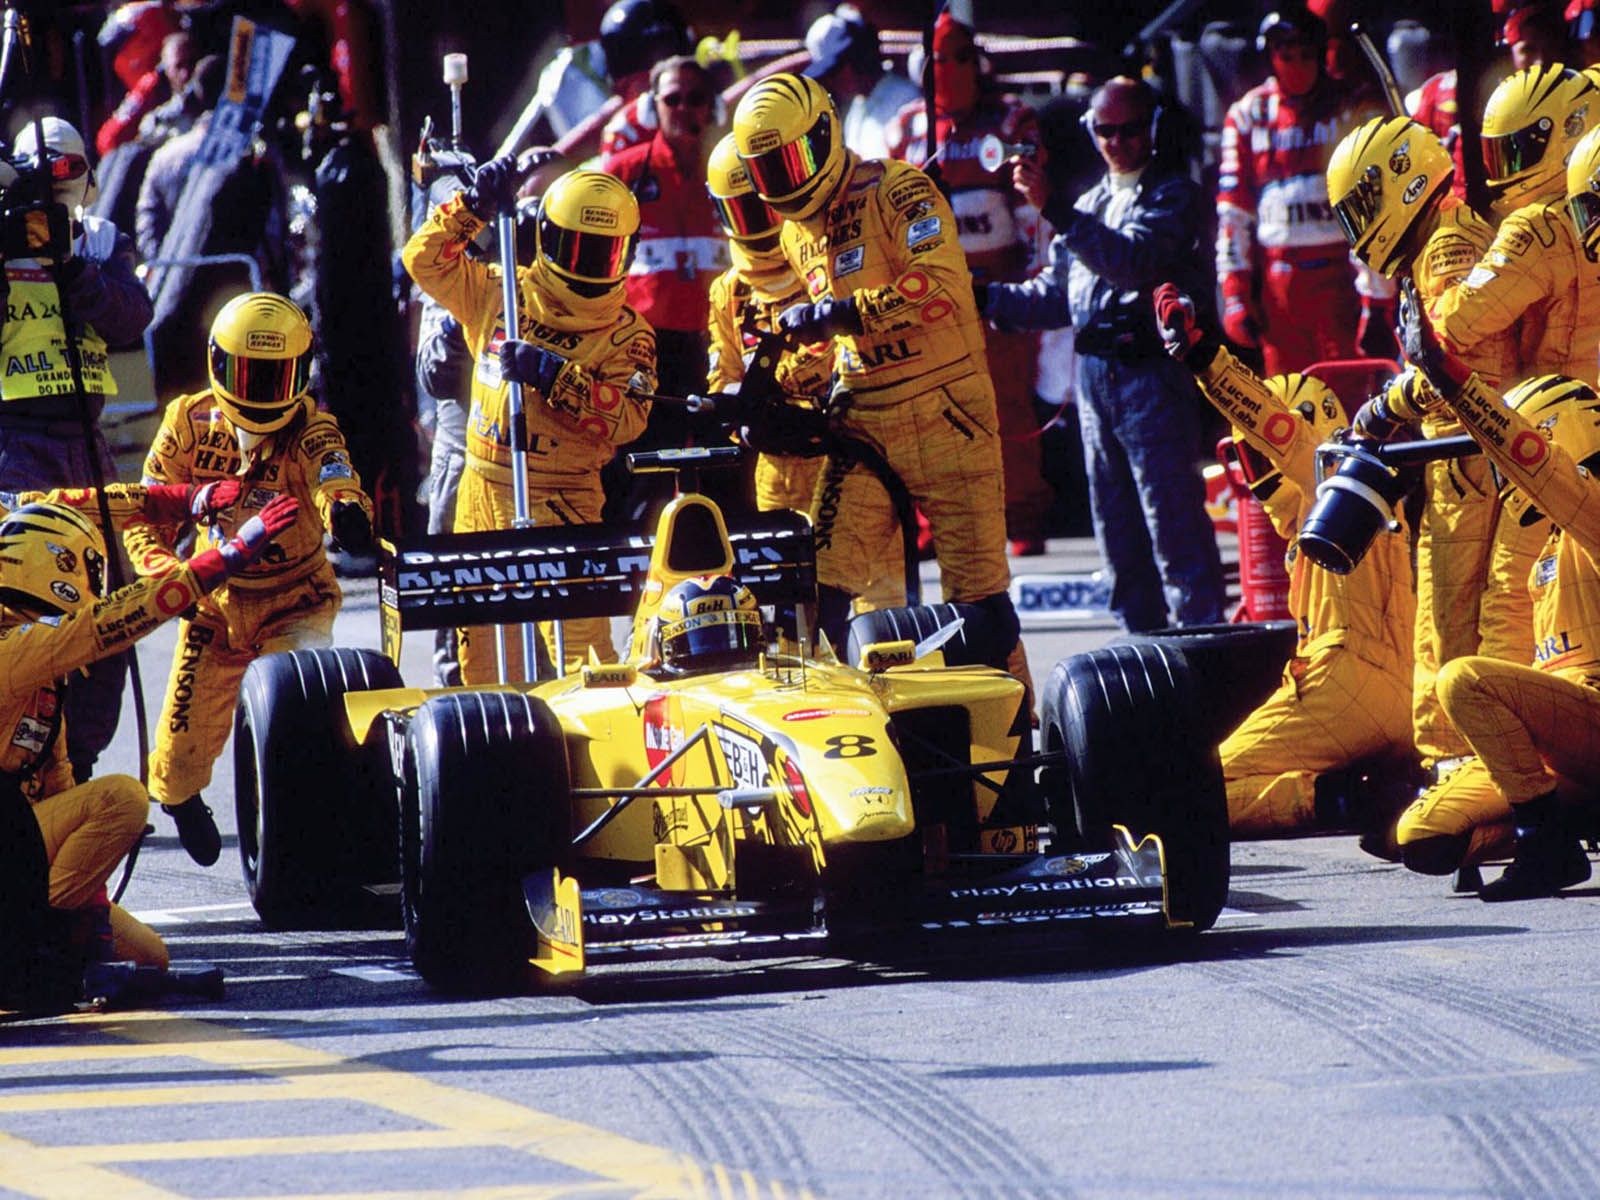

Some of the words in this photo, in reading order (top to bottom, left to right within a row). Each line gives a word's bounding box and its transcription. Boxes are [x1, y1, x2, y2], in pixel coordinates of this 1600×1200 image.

[6, 350, 54, 377] ALL
[1219, 376, 1263, 416] Lucent
[1467, 386, 1511, 430] Lucent
[96, 604, 149, 636] Lucent
[867, 649, 913, 667] PEARL
[1535, 630, 1583, 662] ARL
[823, 734, 878, 760] 8
[951, 875, 1137, 899] PlayStation
